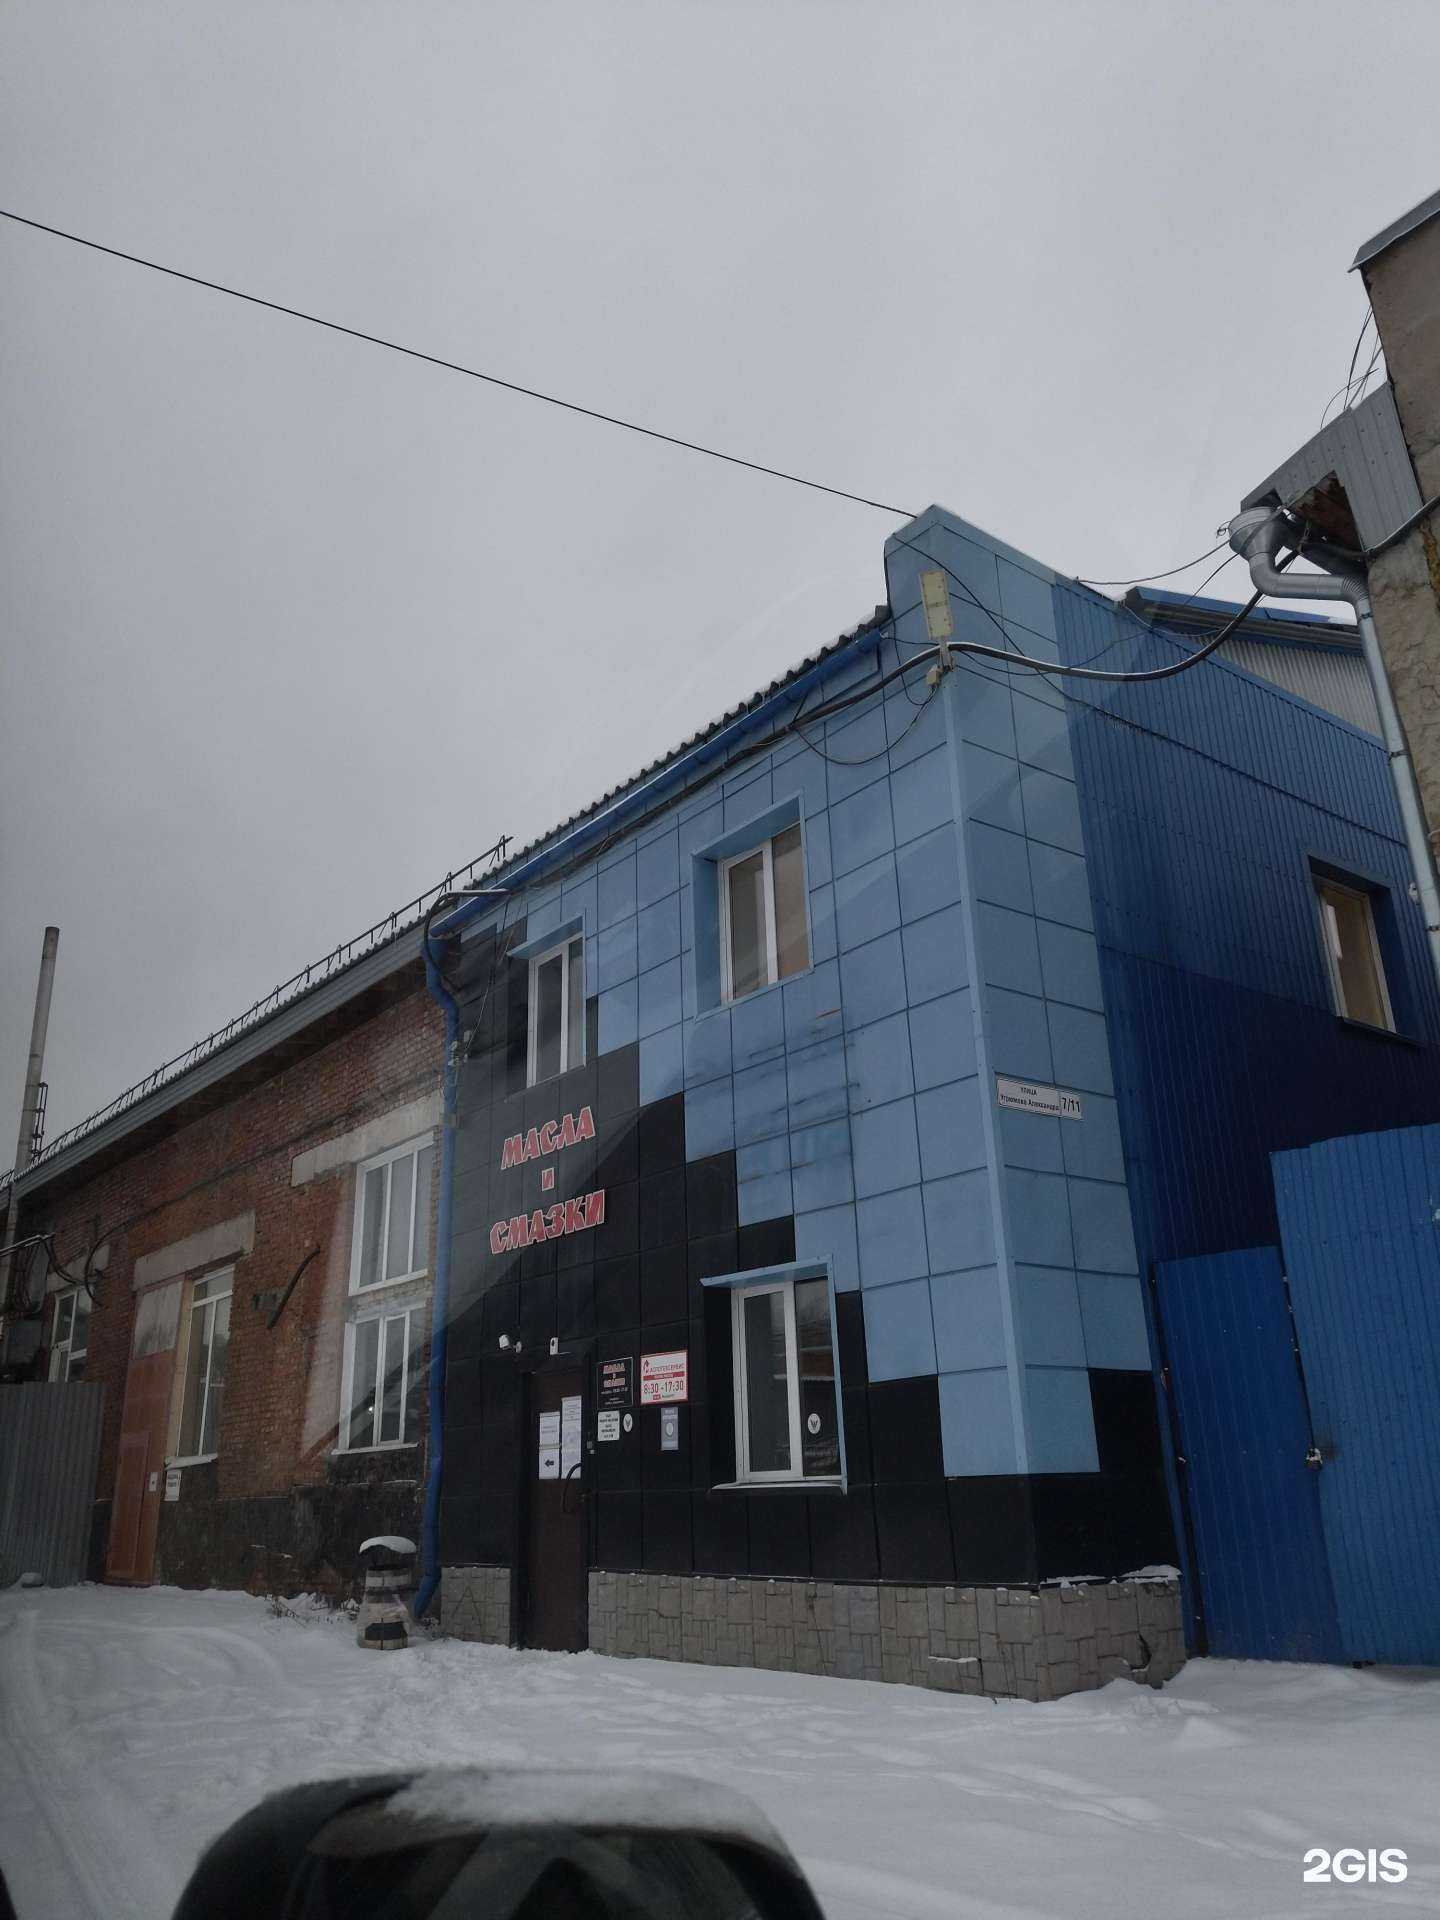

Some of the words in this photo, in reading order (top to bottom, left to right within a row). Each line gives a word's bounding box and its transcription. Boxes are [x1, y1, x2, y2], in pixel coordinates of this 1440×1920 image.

[1061, 1097, 1080, 1113] 7/11
[500, 1105, 596, 1171] МАСЛА
[541, 1167, 555, 1192] И
[489, 1188, 606, 1255] СМАЗКИ
